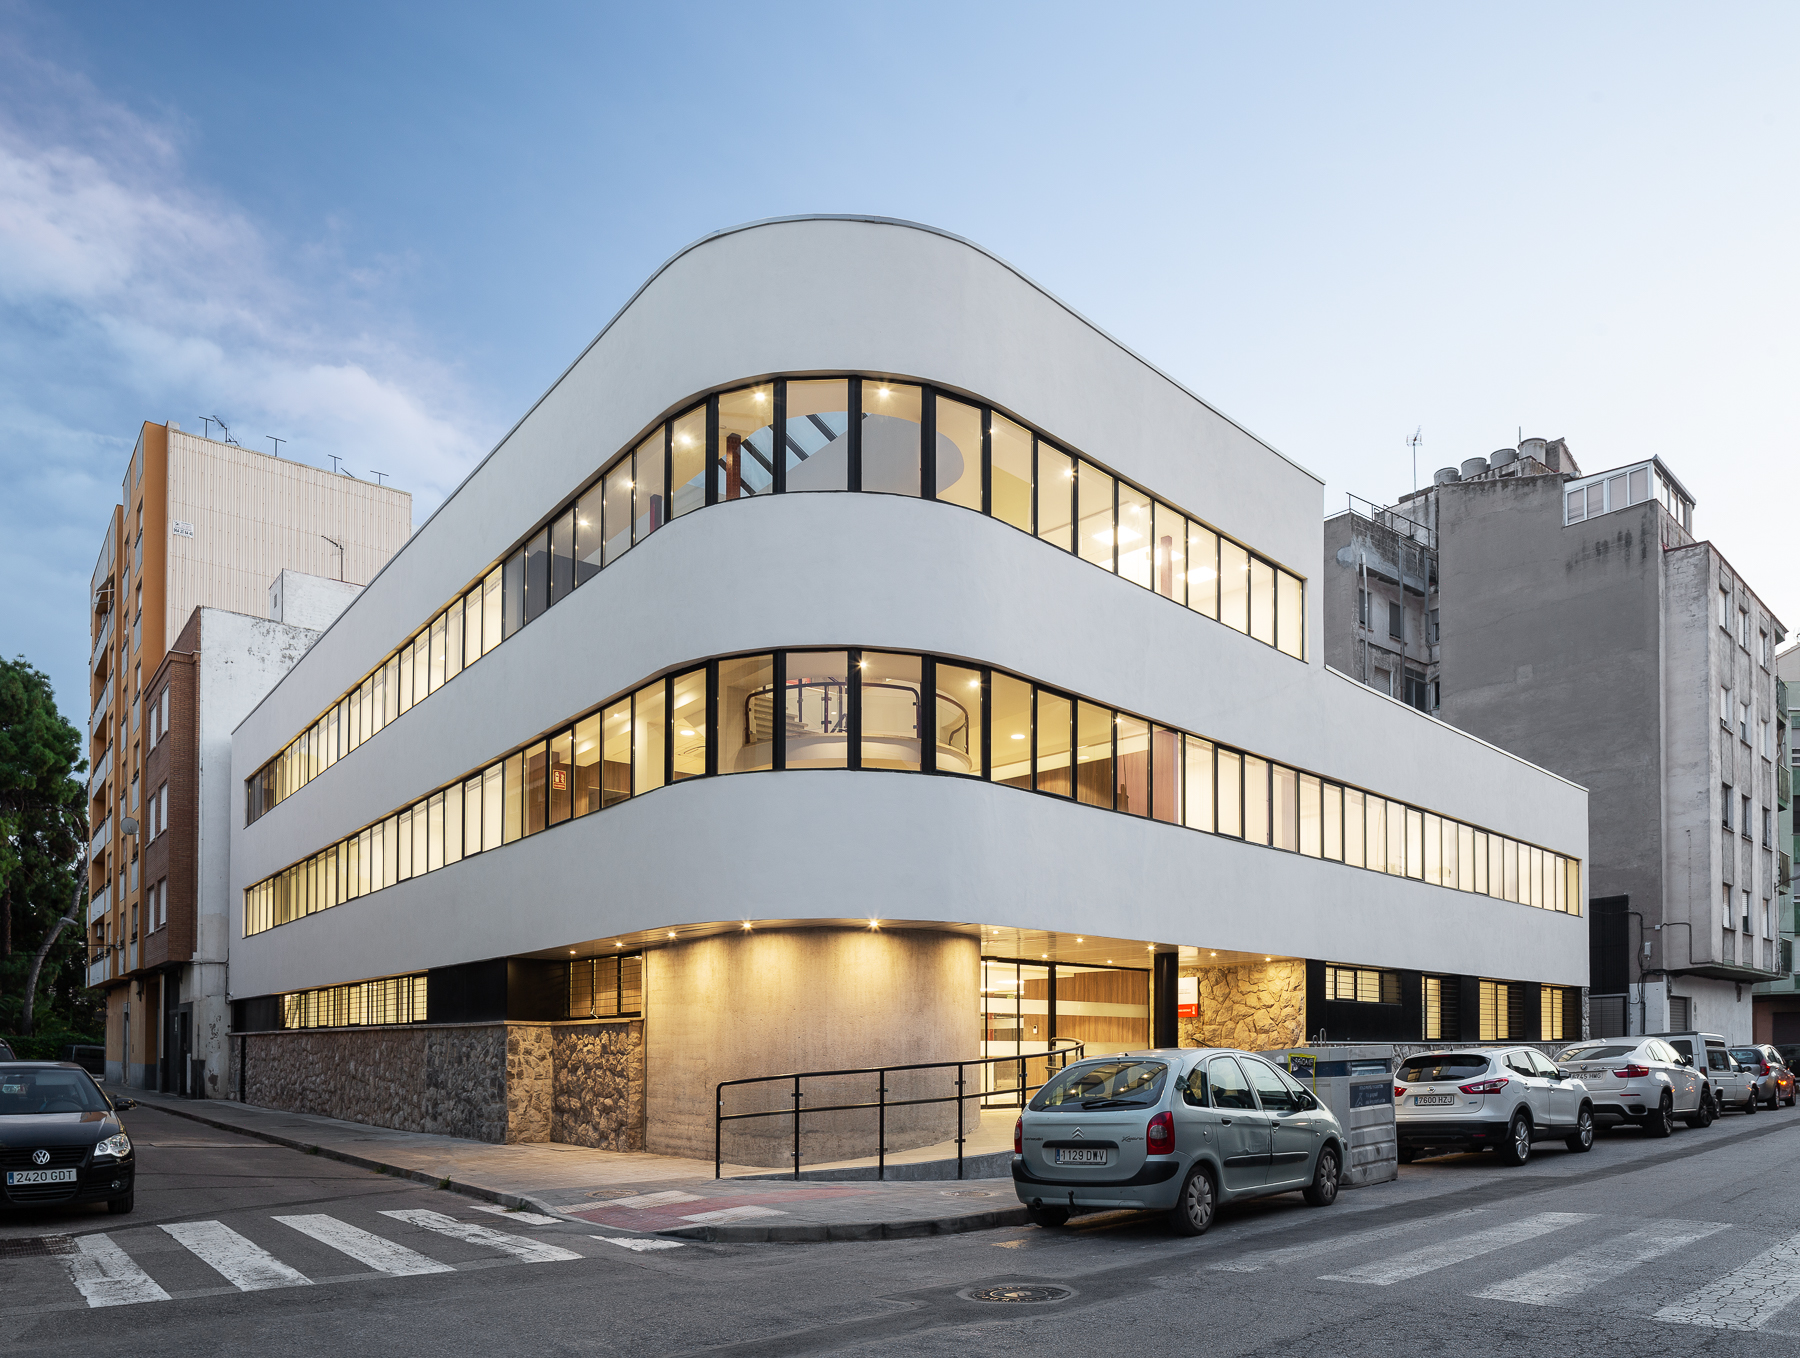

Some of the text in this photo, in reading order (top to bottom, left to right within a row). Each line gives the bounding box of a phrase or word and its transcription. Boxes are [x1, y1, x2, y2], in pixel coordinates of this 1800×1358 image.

[1418, 1096, 1437, 1104] 7600
[1062, 1150, 1104, 1161] 1129 DWV
[16, 1170, 73, 1183] 2420 GDT
